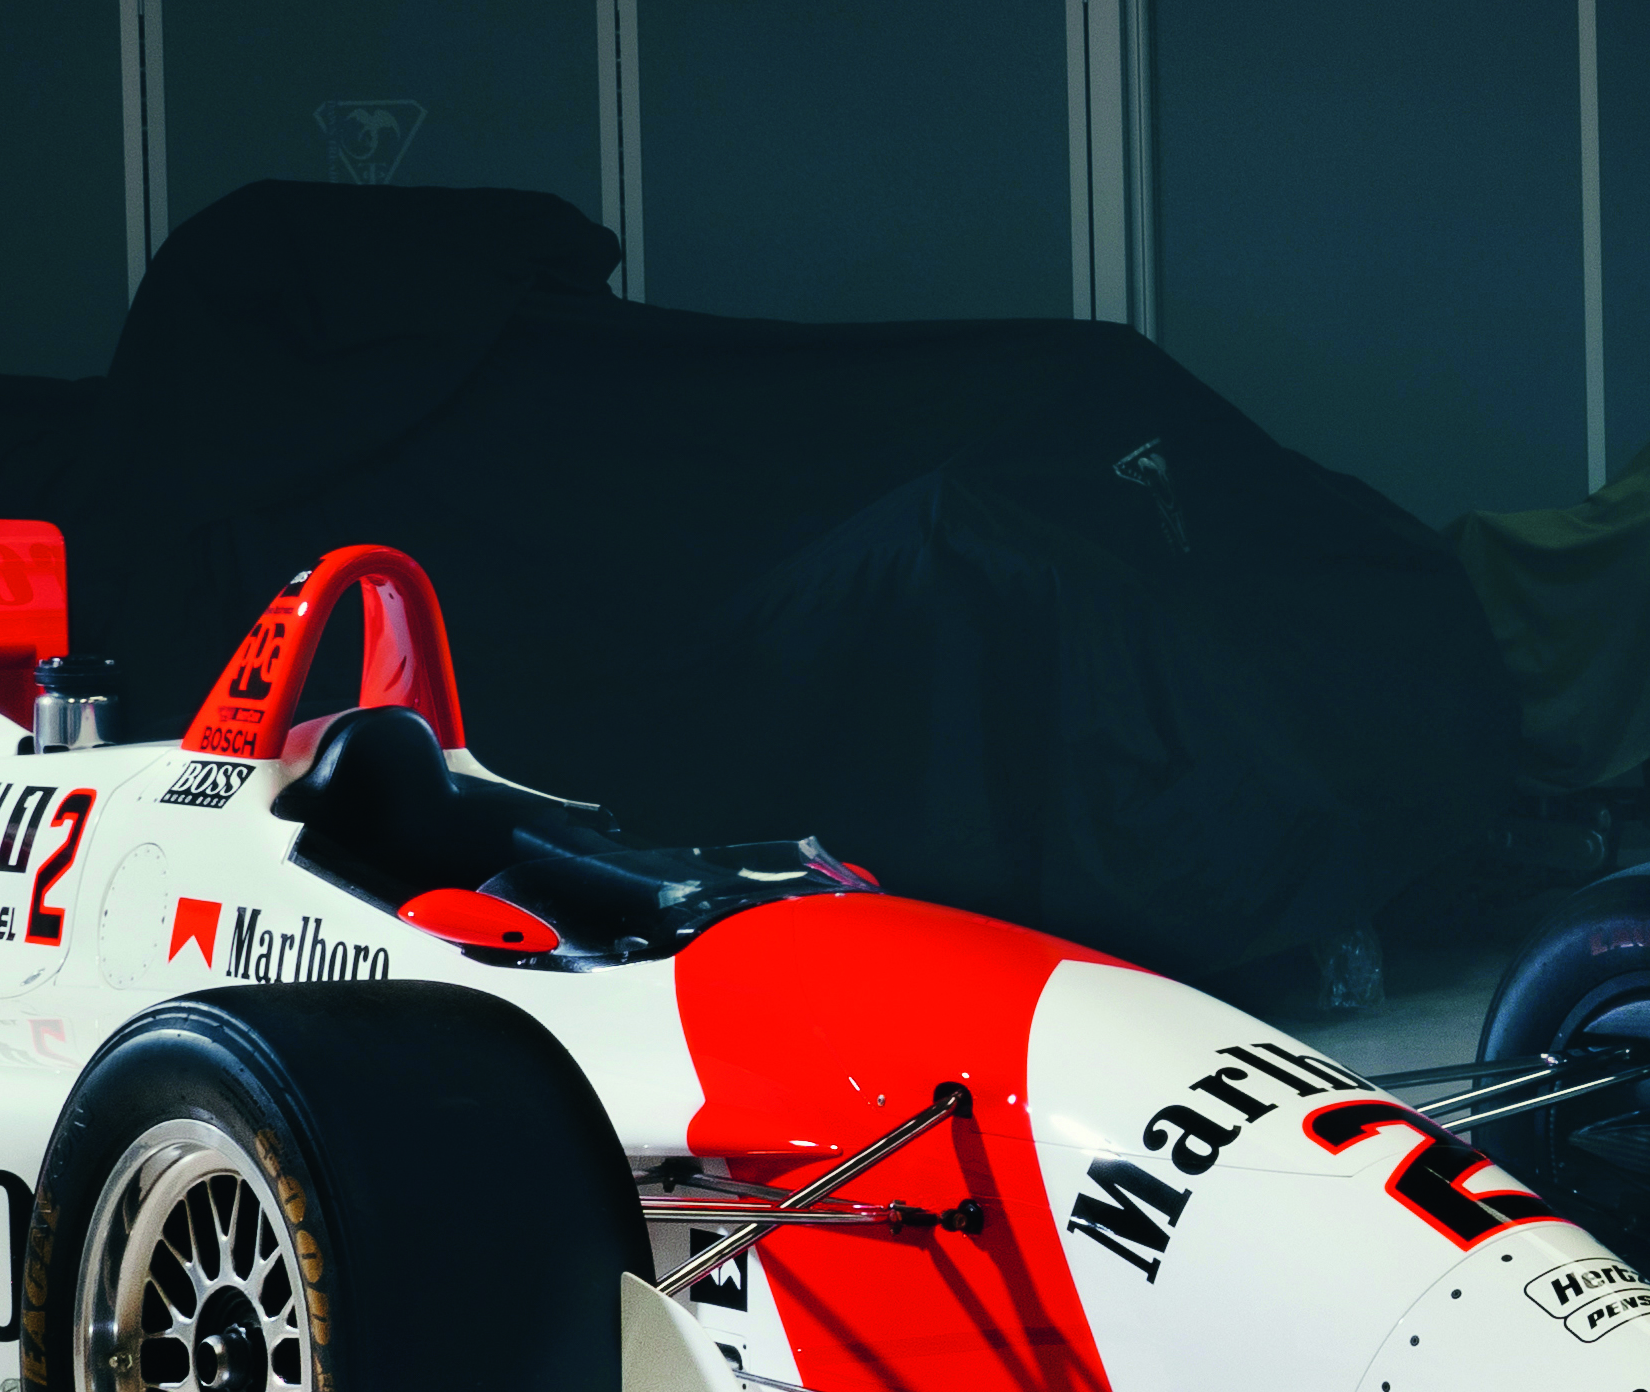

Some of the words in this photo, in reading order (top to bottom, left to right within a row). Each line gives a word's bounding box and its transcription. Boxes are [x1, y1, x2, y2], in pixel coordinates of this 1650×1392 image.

[171, 763, 248, 796] BOSS
[201, 727, 257, 756] BOSCH
[24, 787, 97, 947] 2
[226, 906, 389, 984] Marlboro
[1302, 1098, 1583, 1252] 2
